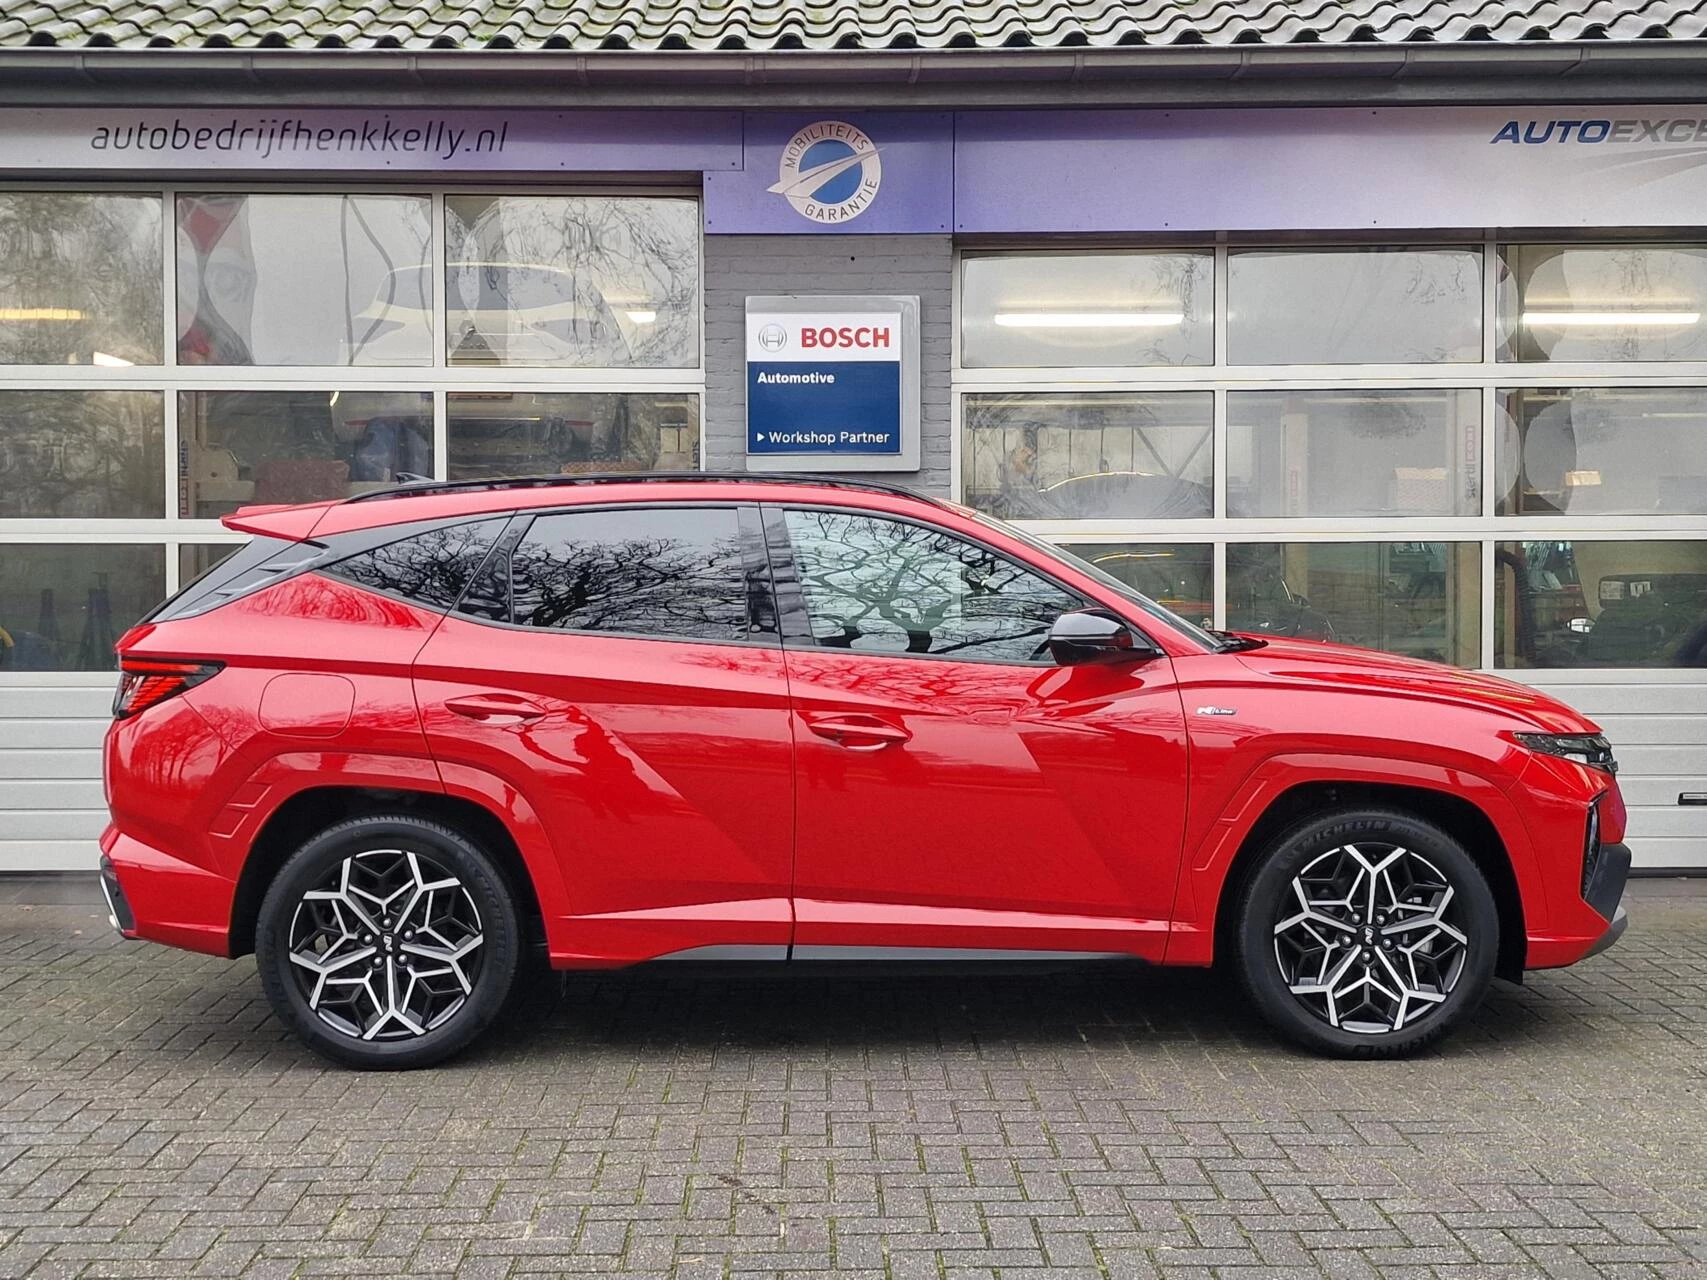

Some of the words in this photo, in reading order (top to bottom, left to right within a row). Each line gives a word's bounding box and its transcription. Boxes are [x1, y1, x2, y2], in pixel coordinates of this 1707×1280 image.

[91, 119, 508, 160] autobedrijfhenkkelly.nl
[785, 124, 869, 168] MOBILITEITS
[804, 178, 878, 221] GARANTIE
[801, 327, 890, 348] BOSCH
[757, 372, 835, 384] Automotive
[769, 431, 836, 445] Workshop
[840, 431, 890, 443] Partner
